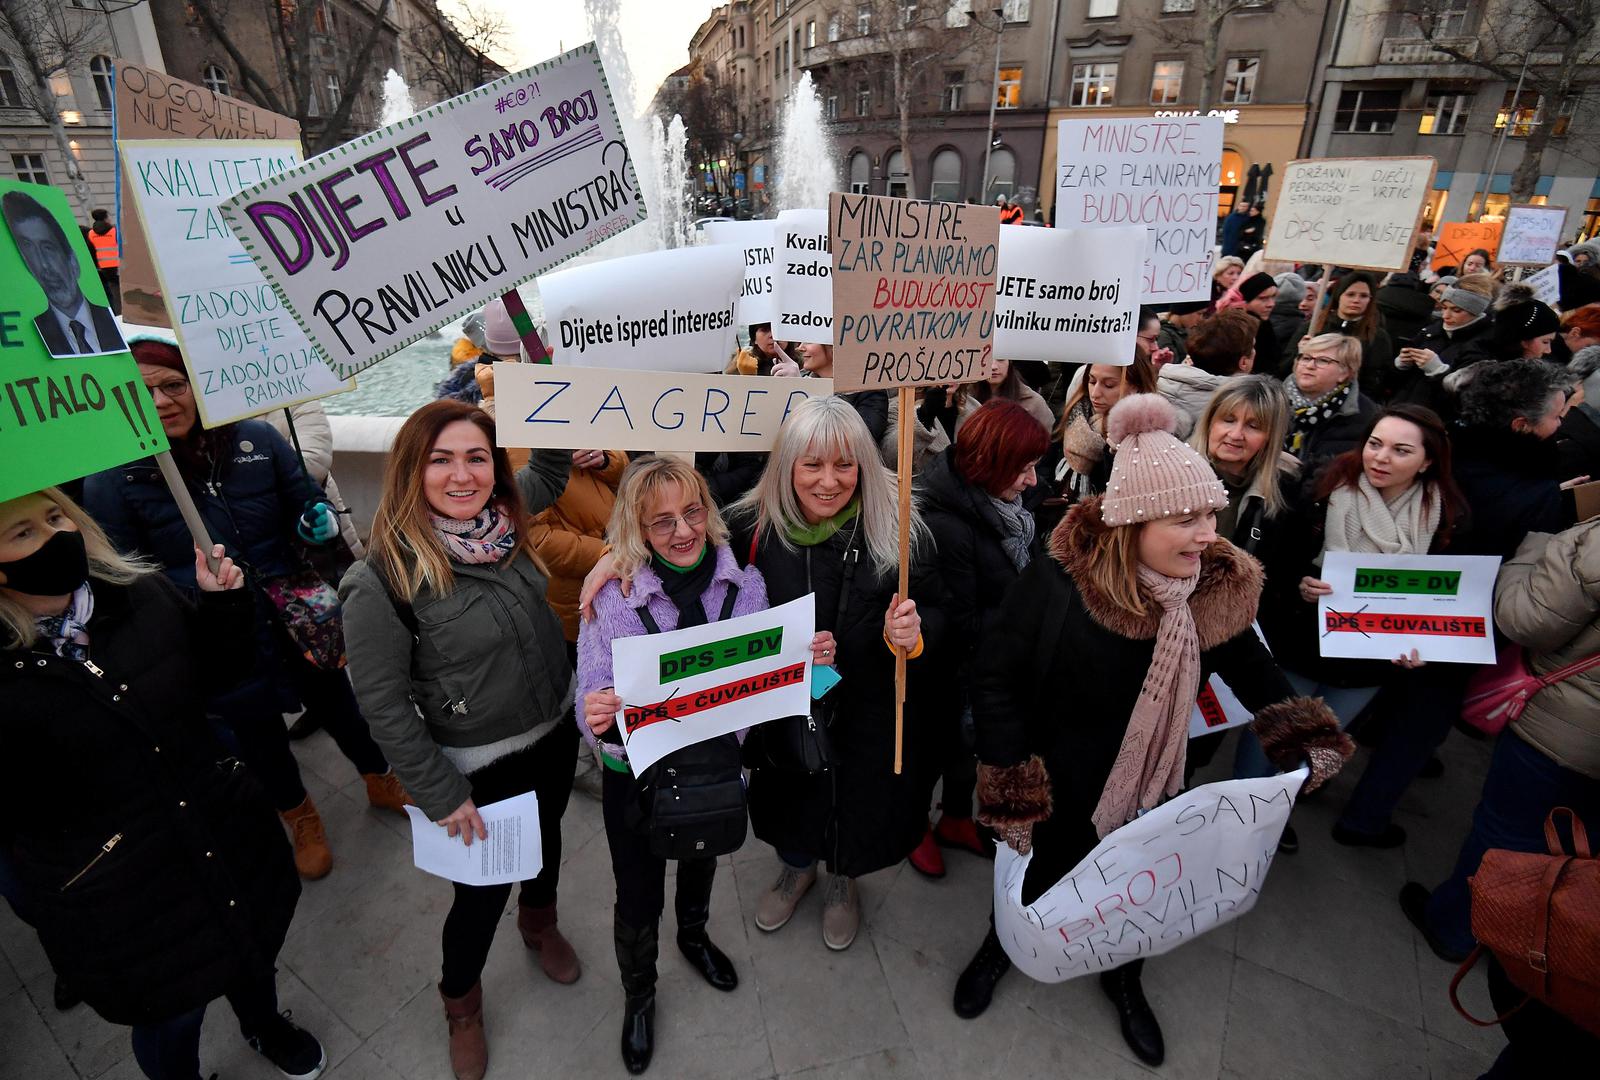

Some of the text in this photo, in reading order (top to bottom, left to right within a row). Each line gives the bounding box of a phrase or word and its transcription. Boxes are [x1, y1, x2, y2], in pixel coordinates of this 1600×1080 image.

[122, 66, 278, 140] ODGOJITELJ
[134, 98, 185, 135] NIJE
[244, 90, 599, 276] DIJETE SAMO BROJ
[1061, 163, 1222, 187] ZAR PLANIRAMO
[837, 194, 967, 243] MINISTRE,
[1081, 189, 1218, 223] BUDUĆNOST
[313, 140, 640, 355] PRAVILNIKU MINISTRA?
[585, 215, 629, 244] ZAGREB
[786, 233, 828, 252] Kvali
[1284, 220, 1325, 242] DPS
[839, 239, 996, 277] ZAR PLANIRAMO
[873, 276, 994, 309] BUDUĆNOST
[996, 276, 1121, 305] JETE samo broj
[216, 317, 285, 354] DIJETE
[559, 302, 735, 353] Dijete ispred interesa!
[781, 311, 832, 328] zadov
[840, 310, 995, 346] POVRATKOM U
[995, 309, 1131, 334] vilniku ministra?!
[198, 346, 321, 395] ZADOVOLJA
[862, 344, 991, 385] PROŠLOST?
[244, 372, 311, 408] RADNIK
[0, 373, 158, 450] ITALO!!
[1355, 573, 1399, 588] DPS
[1427, 575, 1460, 591] DV
[1326, 616, 1360, 629] DPS
[1380, 617, 1485, 635] ČUVALIŠTE
[661, 649, 715, 678] DPS
[747, 634, 783, 657] DV
[625, 704, 668, 728] DPS
[695, 665, 805, 709] ČUVALIŠTE
[1059, 852, 1182, 943] BROJ
